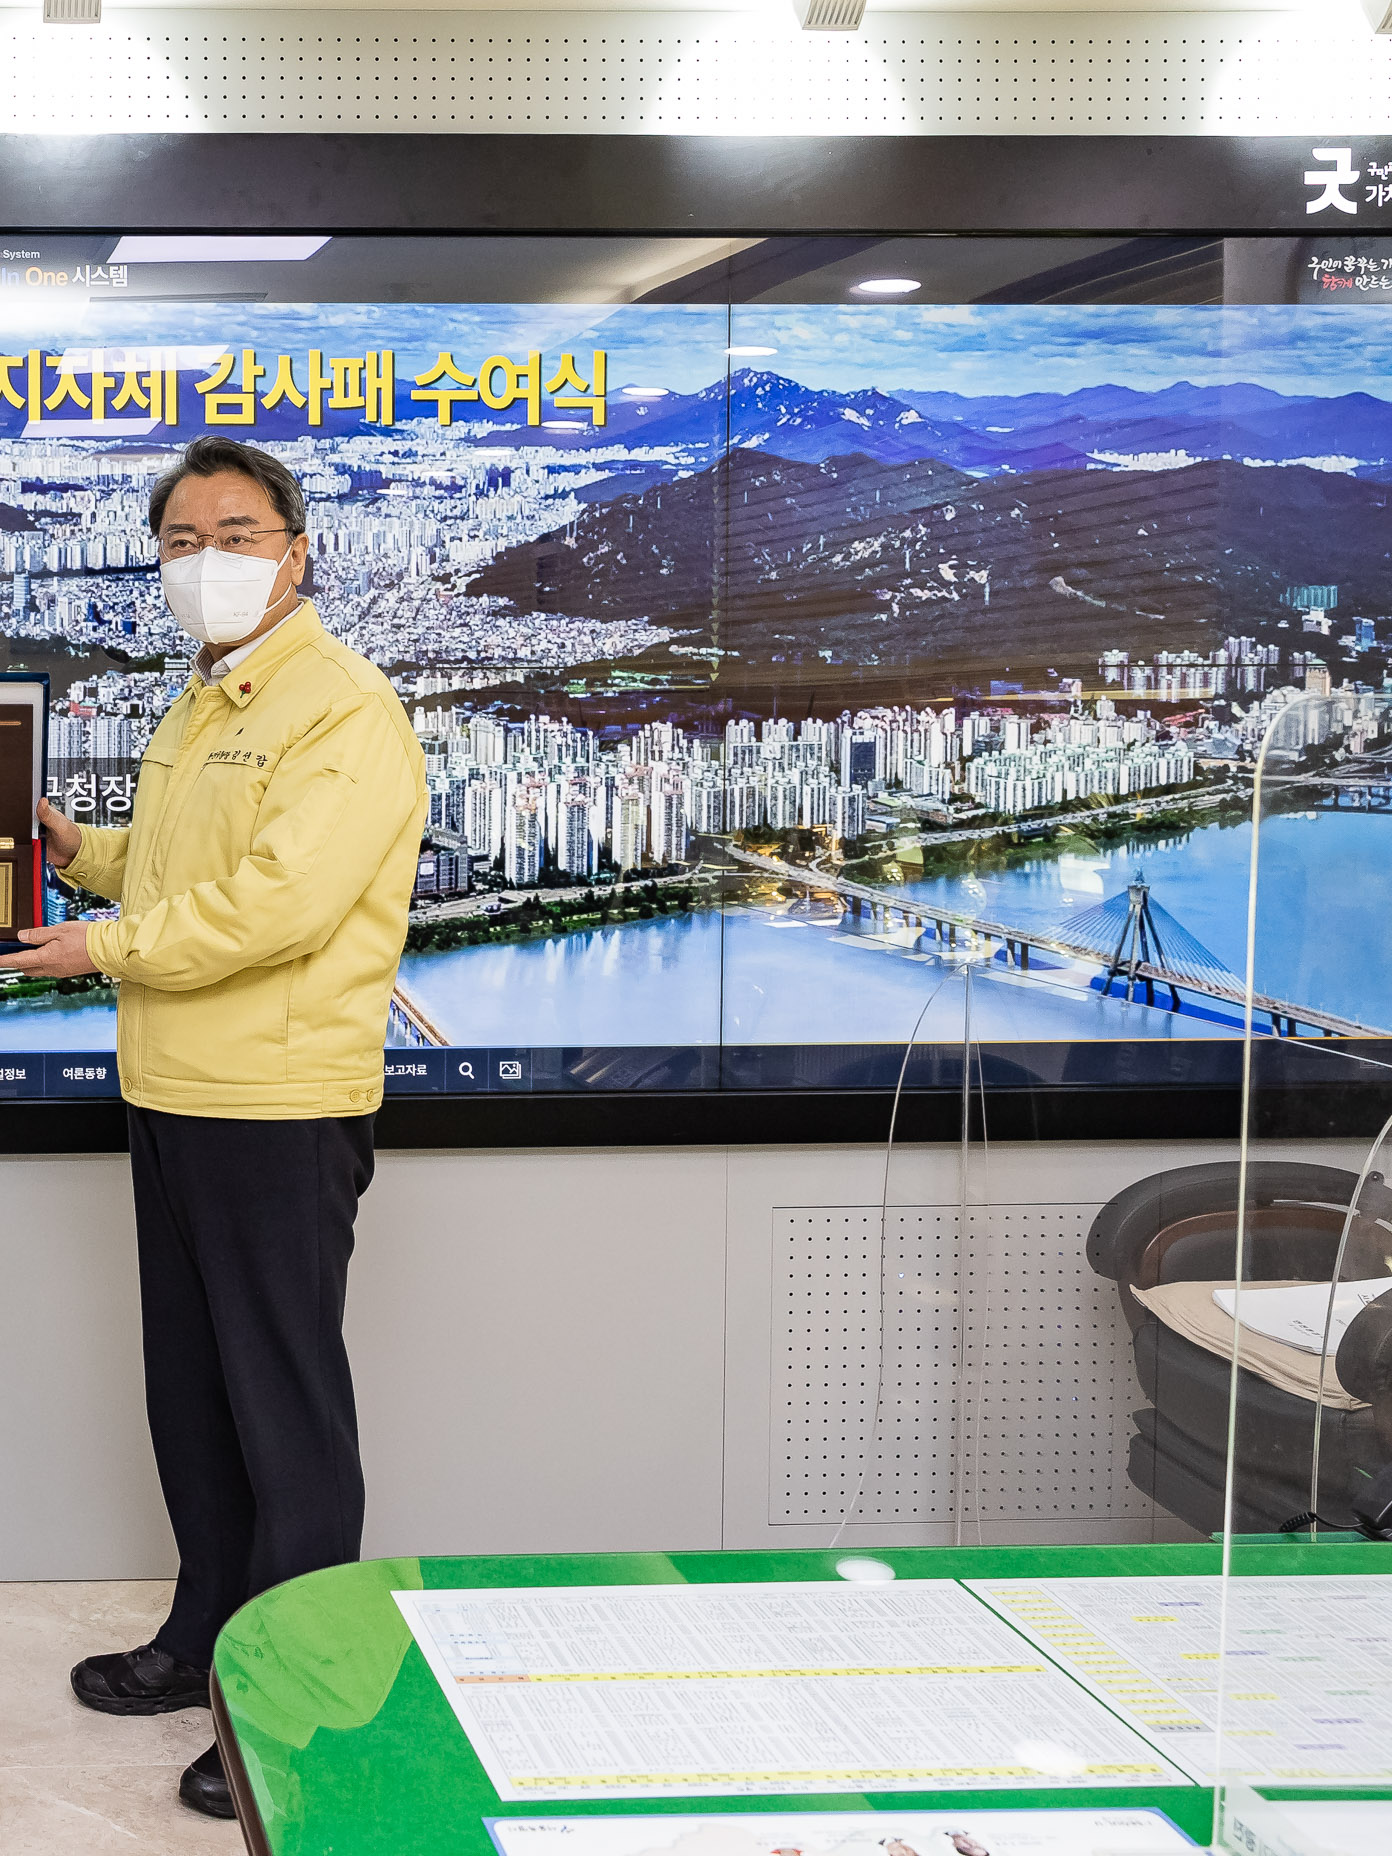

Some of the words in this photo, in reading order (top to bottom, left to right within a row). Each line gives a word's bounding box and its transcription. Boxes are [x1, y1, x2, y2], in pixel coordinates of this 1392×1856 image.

[2, 248, 41, 261] System
[1, 266, 20, 286] In
[25, 265, 69, 287] One
[71, 264, 128, 288] 시스템
[195, 348, 394, 427] 감사패
[410, 349, 606, 427] 수여식
[62, 1066, 107, 1081] 여론동향
[384, 1063, 428, 1077] 보고자료
